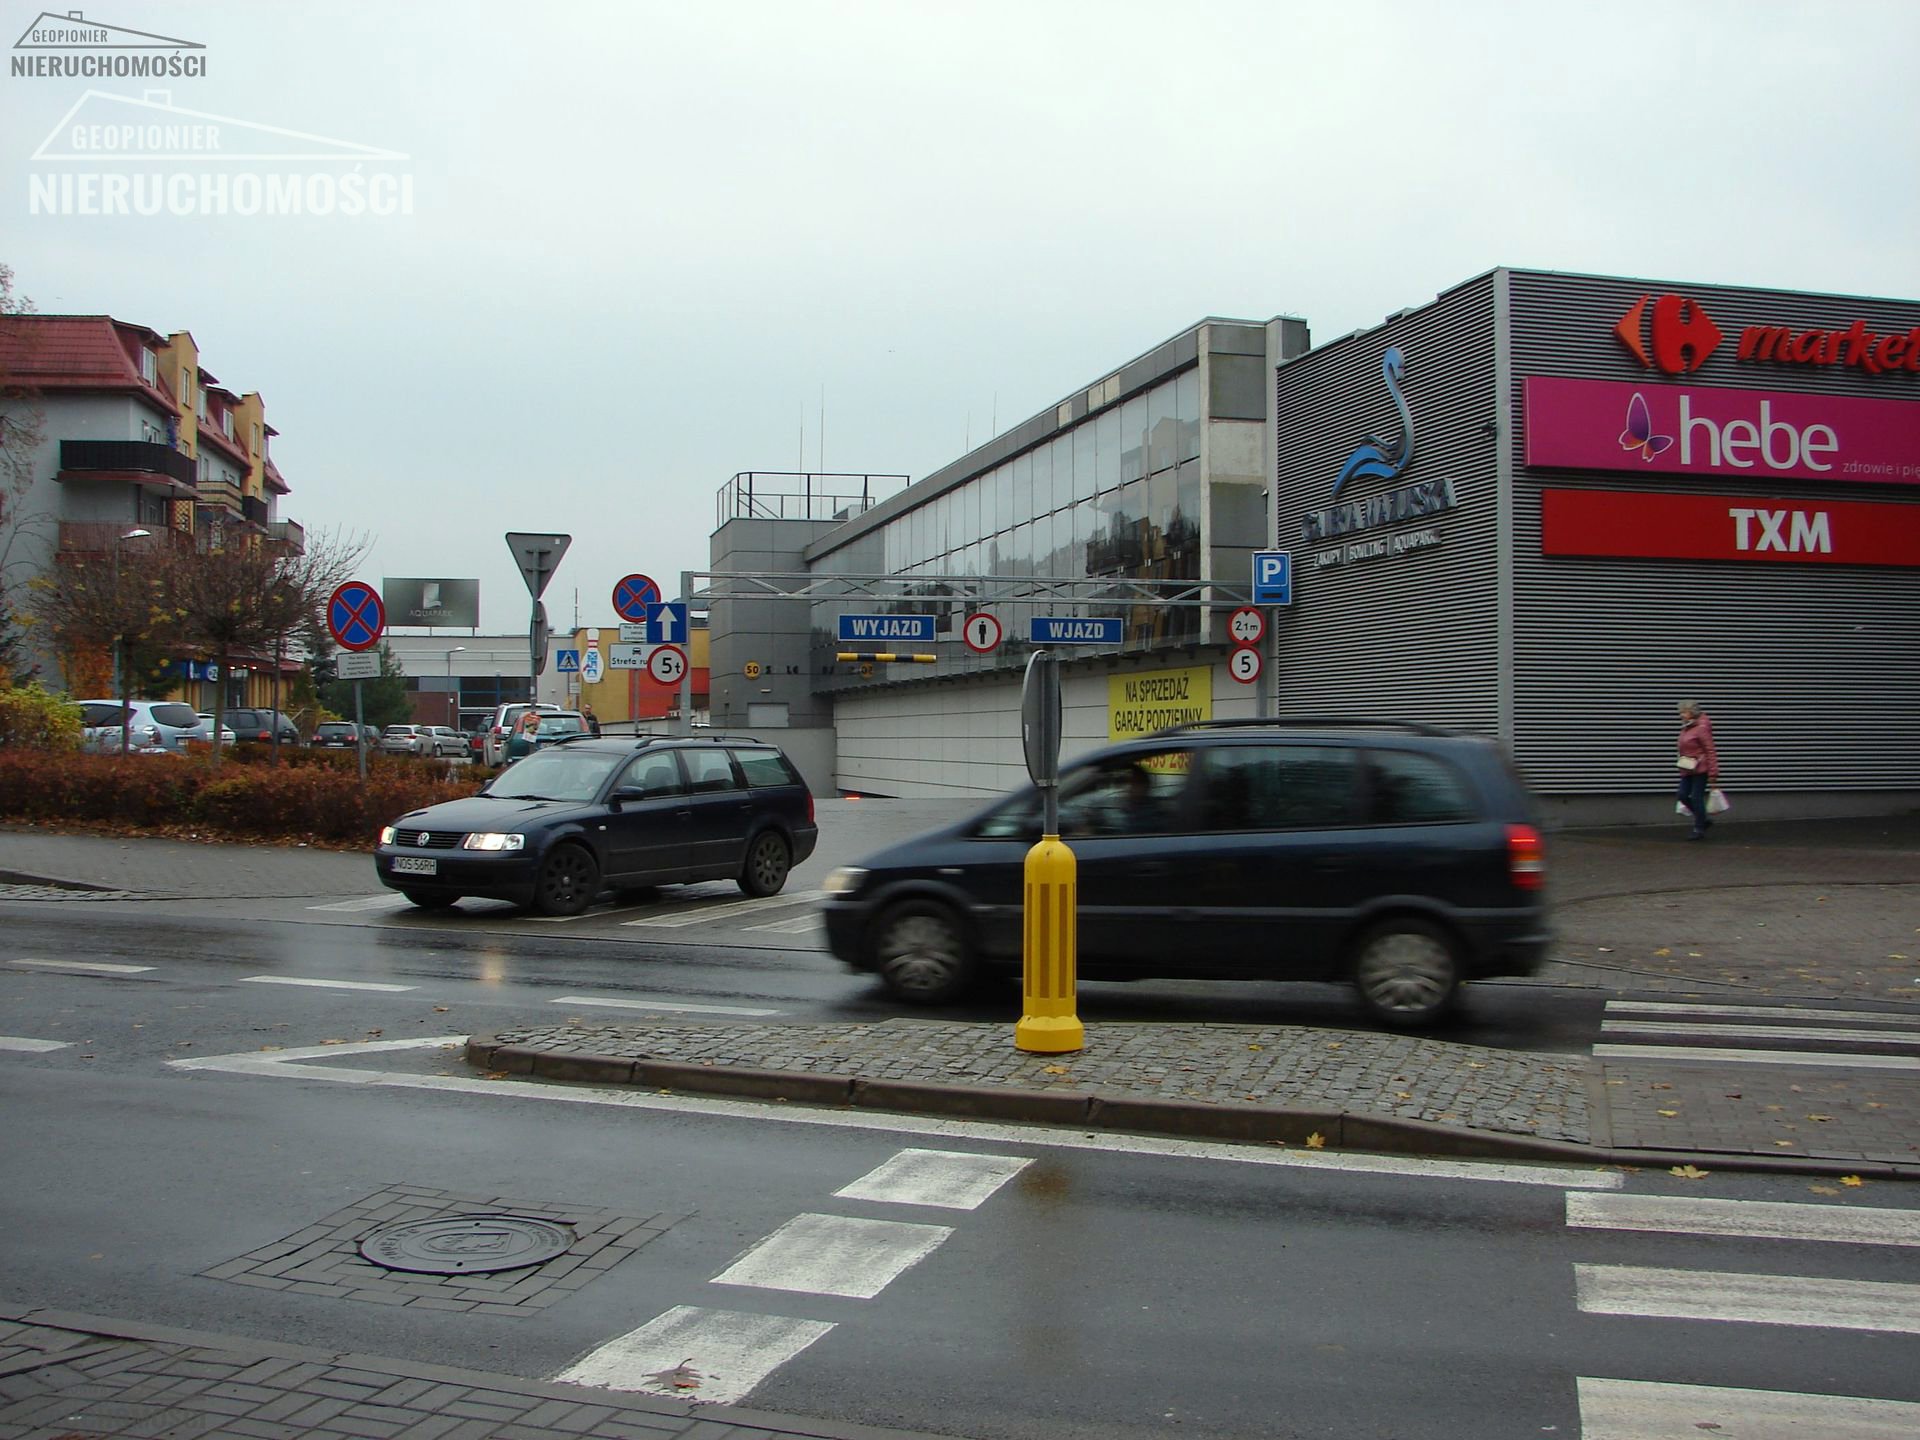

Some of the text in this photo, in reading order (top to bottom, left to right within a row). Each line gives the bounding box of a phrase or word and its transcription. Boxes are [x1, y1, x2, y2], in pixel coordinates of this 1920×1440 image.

[1735, 320, 1920, 374] market
[1679, 395, 1839, 472] hebe
[1842, 460, 1893, 475] zdrowie
[1729, 508, 1832, 553] TXM
[1350, 537, 1386, 561] BOWLING
[1262, 559, 1281, 583] P
[852, 620, 922, 637] WYJAZD
[1049, 622, 1105, 639] WJAZD
[611, 657, 637, 665] Strefa
[746, 665, 759, 675] 50
[1241, 656, 1251, 673] 5
[1125, 672, 1189, 703] NA SPRZEDAŻ
[1114, 704, 1145, 732] GARAŻ
